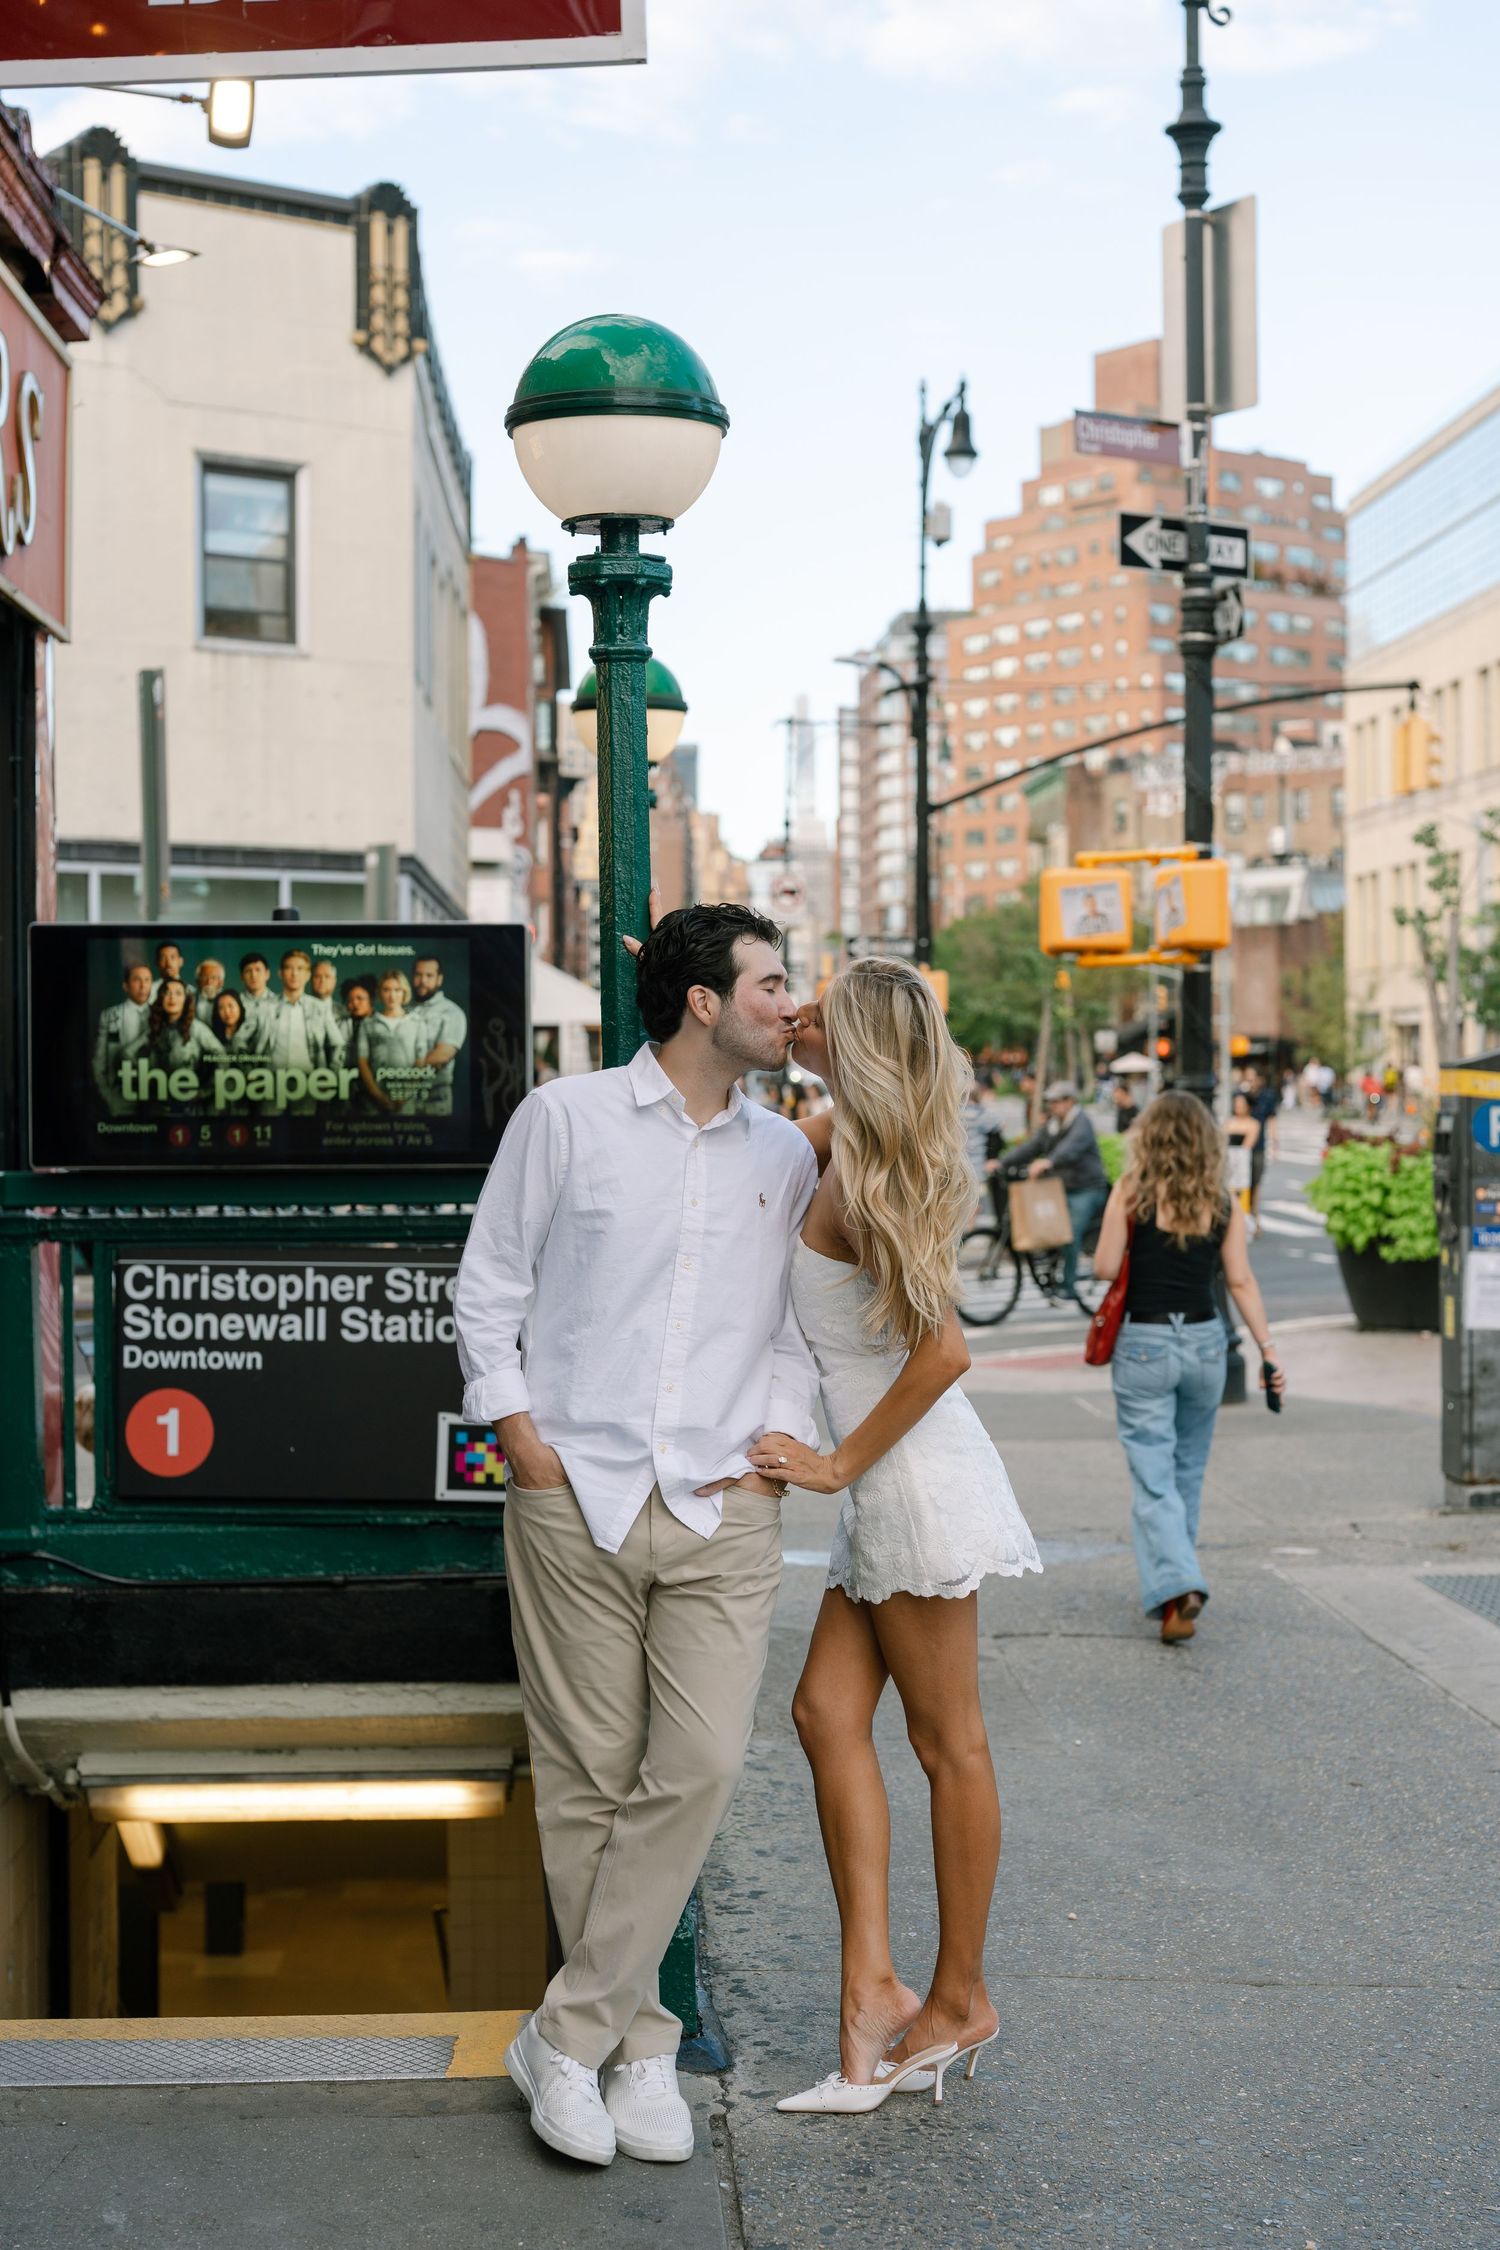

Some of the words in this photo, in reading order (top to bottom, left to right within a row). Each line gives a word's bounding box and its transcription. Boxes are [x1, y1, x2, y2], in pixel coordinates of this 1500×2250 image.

[1077, 416, 1161, 451] Christopher
[1145, 531, 1180, 554] ONE
[311, 943, 353, 958] They've
[355, 943, 376, 956] Got
[377, 943, 416, 956] Issues.
[118, 1058, 199, 1101] the
[214, 1067, 359, 1110] paper
[376, 1065, 436, 1082] peacock
[97, 1121, 158, 1134] Downtown
[174, 1129, 184, 1143] 1
[200, 1124, 212, 1140] 5
[232, 1129, 242, 1143] 1
[253, 1125, 272, 1140] 11
[123, 1264, 373, 1311] Christopher
[122, 1303, 327, 1342] Stonewall
[122, 1344, 263, 1371] Downtown
[156, 1407, 180, 1457] 1
